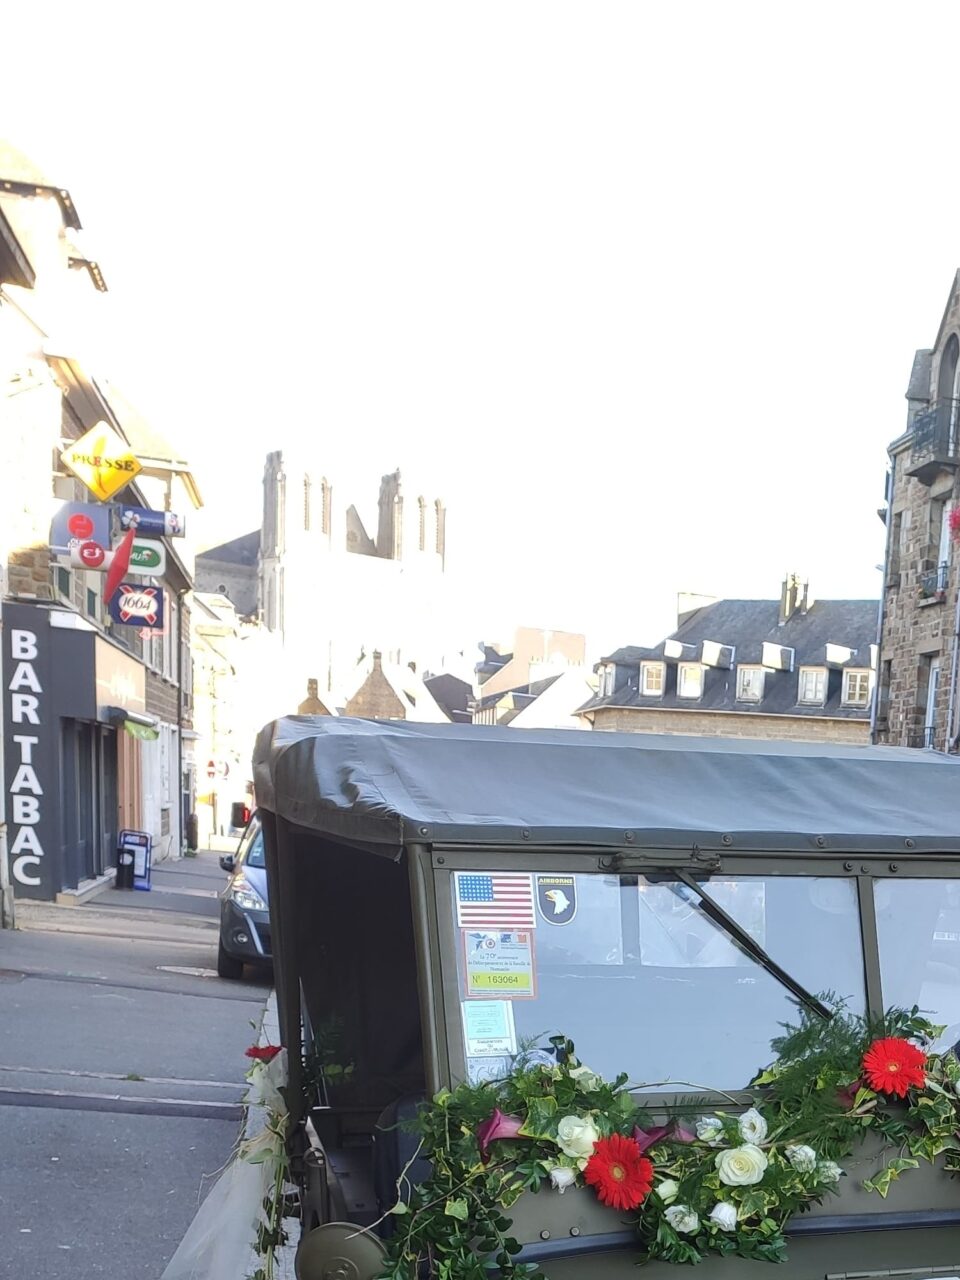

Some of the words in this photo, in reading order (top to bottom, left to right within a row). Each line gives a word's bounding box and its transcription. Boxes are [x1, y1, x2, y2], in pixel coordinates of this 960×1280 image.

[71, 452, 135, 472] PRESSE
[122, 595, 151, 611] 1664
[9, 628, 43, 726] BAR
[9, 734, 45, 887] TABAC
[538, 877, 573, 886] AIRBORNE
[487, 975, 519, 984] 163064
